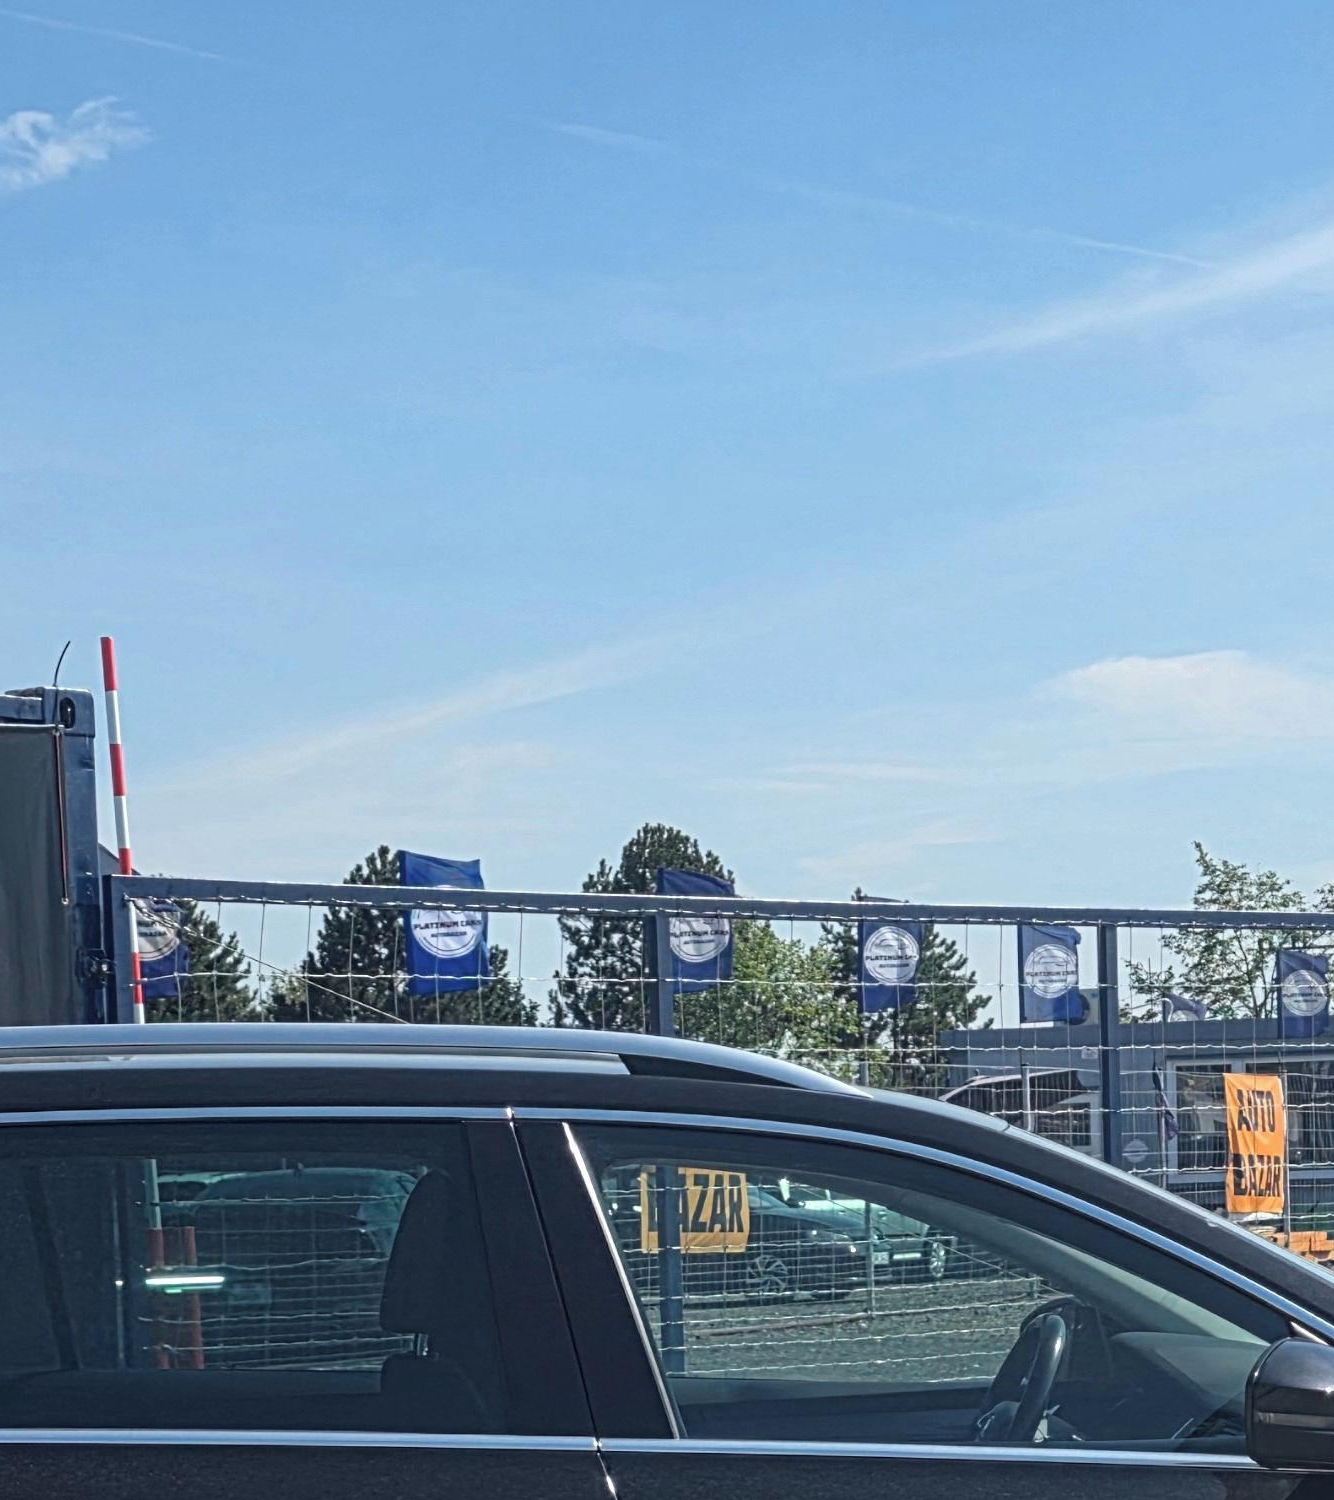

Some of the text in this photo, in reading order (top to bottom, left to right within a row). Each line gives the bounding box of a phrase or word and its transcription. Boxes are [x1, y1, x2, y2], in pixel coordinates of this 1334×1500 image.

[413, 921, 459, 931] PLATINUM
[1237, 1088, 1276, 1132] AUTO
[1233, 1153, 1281, 1197] BAZAR
